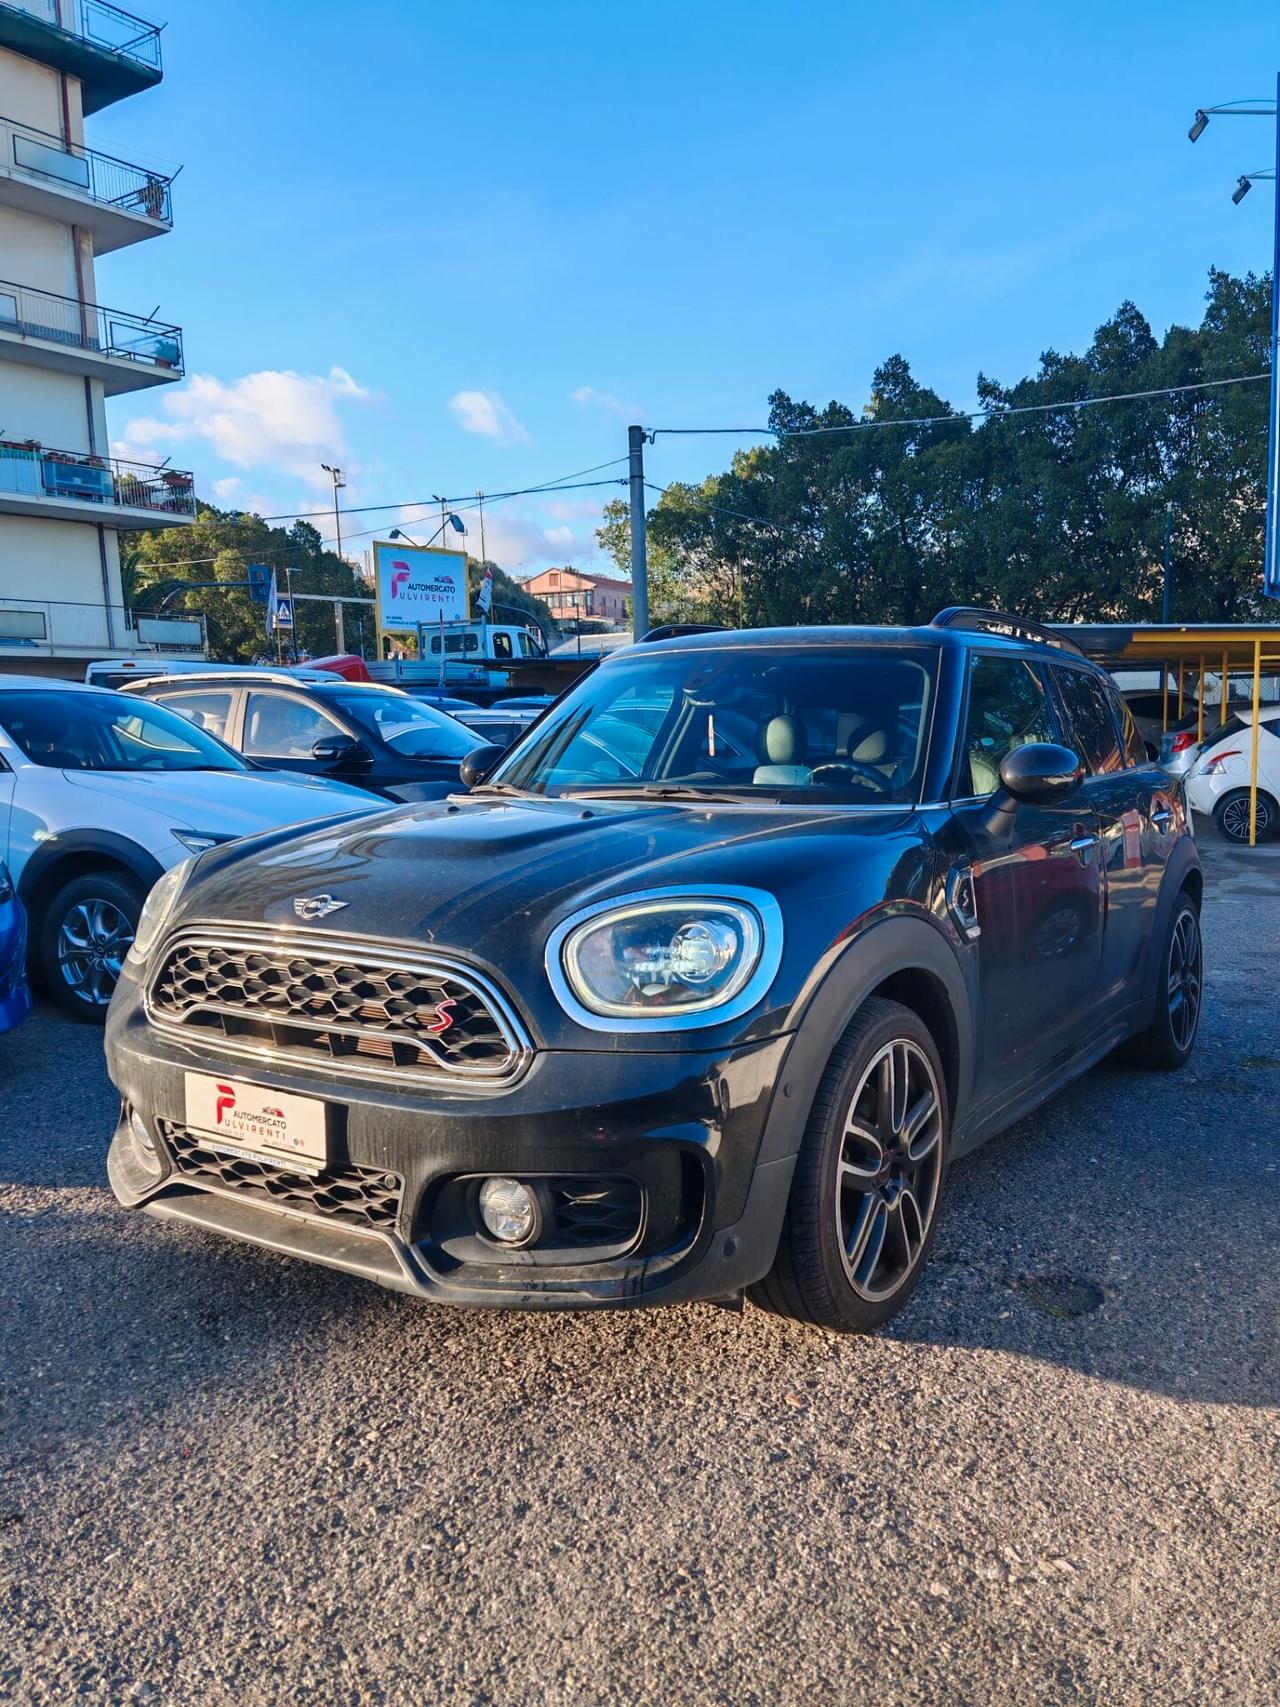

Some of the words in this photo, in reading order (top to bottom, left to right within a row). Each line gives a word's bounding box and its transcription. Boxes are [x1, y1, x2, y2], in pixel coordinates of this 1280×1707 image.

[408, 583, 456, 593] AUTOMERCATO
[427, 998, 457, 1033] S
[233, 1110, 287, 1129] AUTOMERCATO
